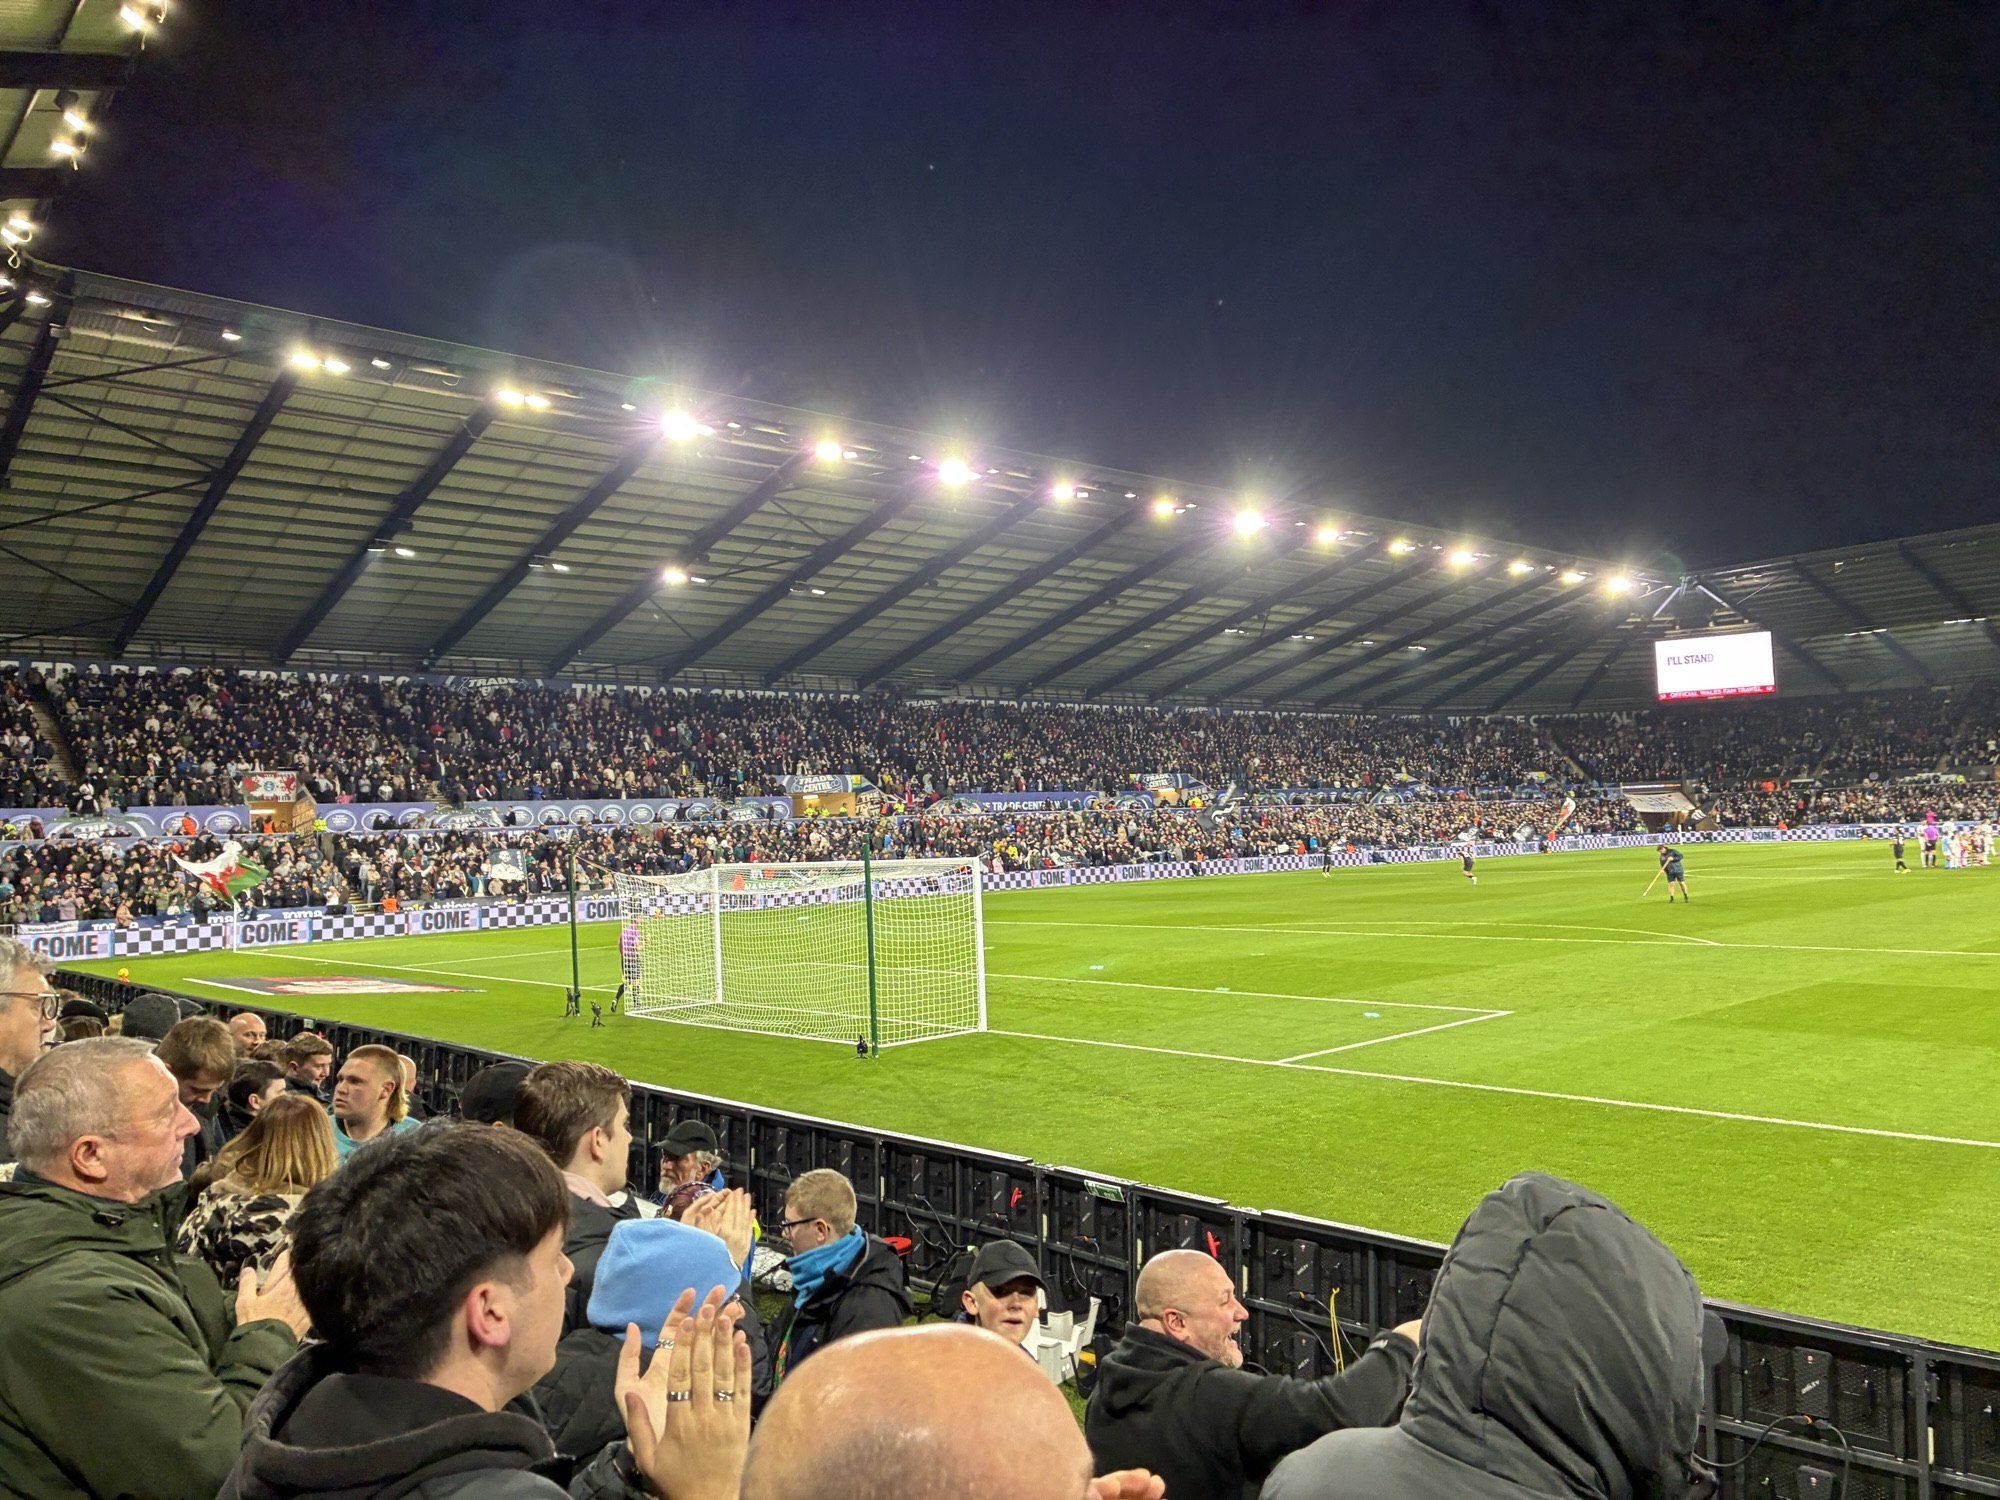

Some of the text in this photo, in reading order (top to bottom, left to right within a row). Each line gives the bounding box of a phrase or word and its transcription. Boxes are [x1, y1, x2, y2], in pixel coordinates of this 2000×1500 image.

[1667, 654, 1714, 666] I'LL STAND
[1670, 690, 1698, 698] OFFICIAL
[1700, 688, 1722, 696] WALES
[799, 774, 834, 784] TRADE
[803, 782, 832, 793] CENTRE
[1752, 831, 1776, 840] COME
[1835, 828, 1860, 839] COME
[1244, 858, 1266, 871] COME
[1309, 855, 1324, 867] COM
[1040, 871, 1066, 886] COME
[1122, 866, 1146, 879] COME
[587, 900, 620, 919] COM
[422, 910, 470, 931] COME
[242, 921, 298, 944] COME
[33, 935, 98, 957] COME
